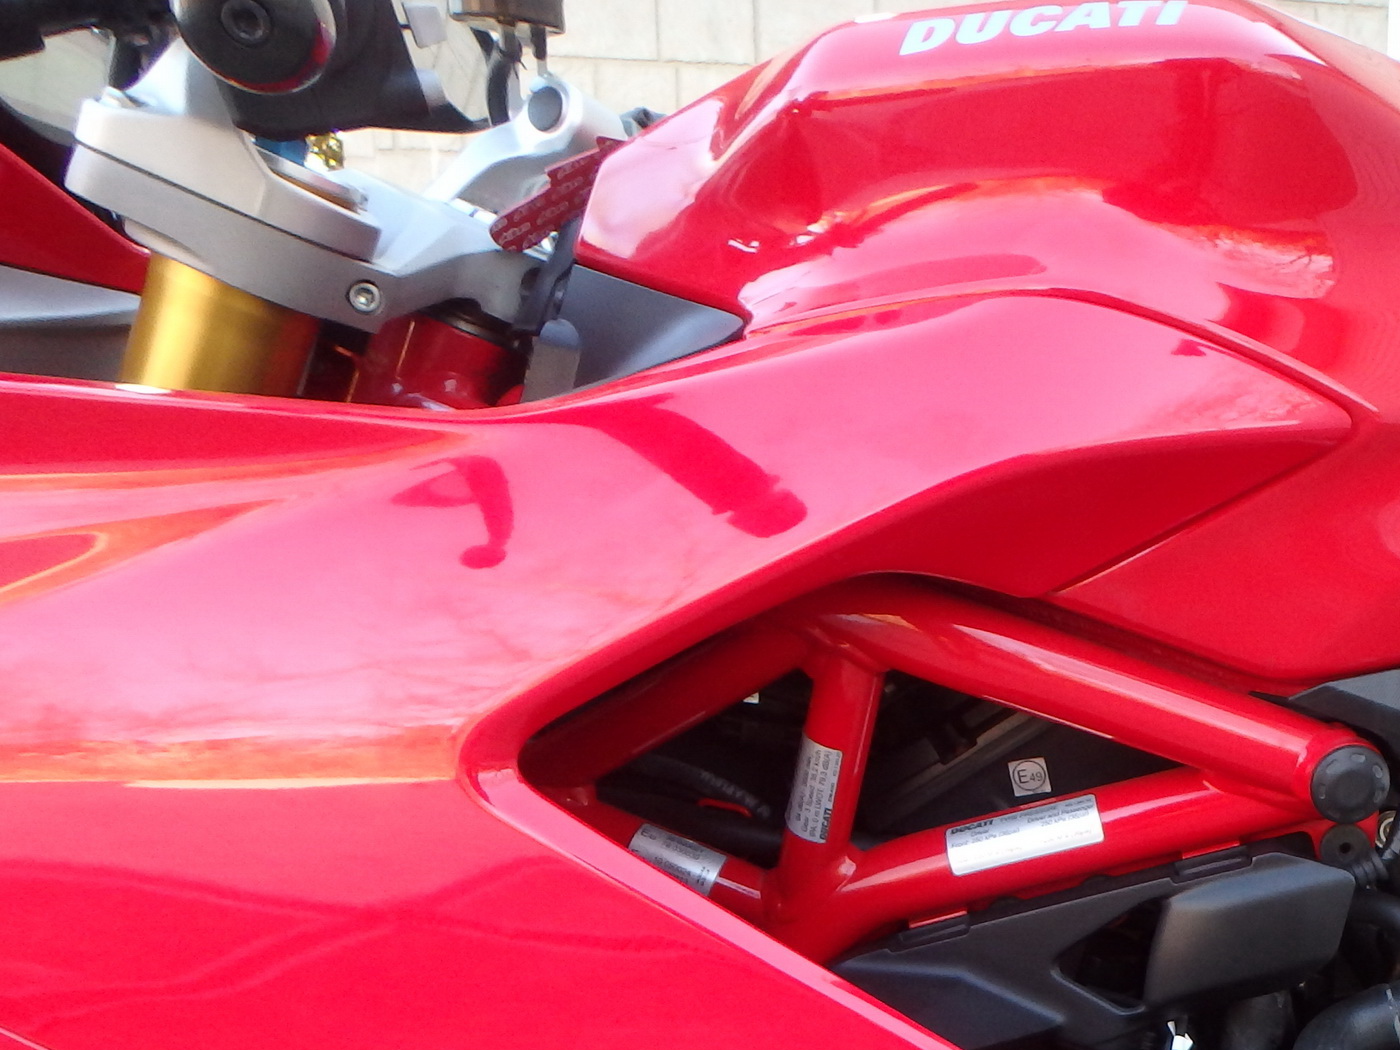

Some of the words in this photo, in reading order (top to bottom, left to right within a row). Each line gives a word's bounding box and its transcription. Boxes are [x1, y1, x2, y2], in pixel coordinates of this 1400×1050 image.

[898, 0, 1189, 56] DUCATI
[820, 807, 832, 840] DUCATI
[950, 820, 994, 834] DUCATI
